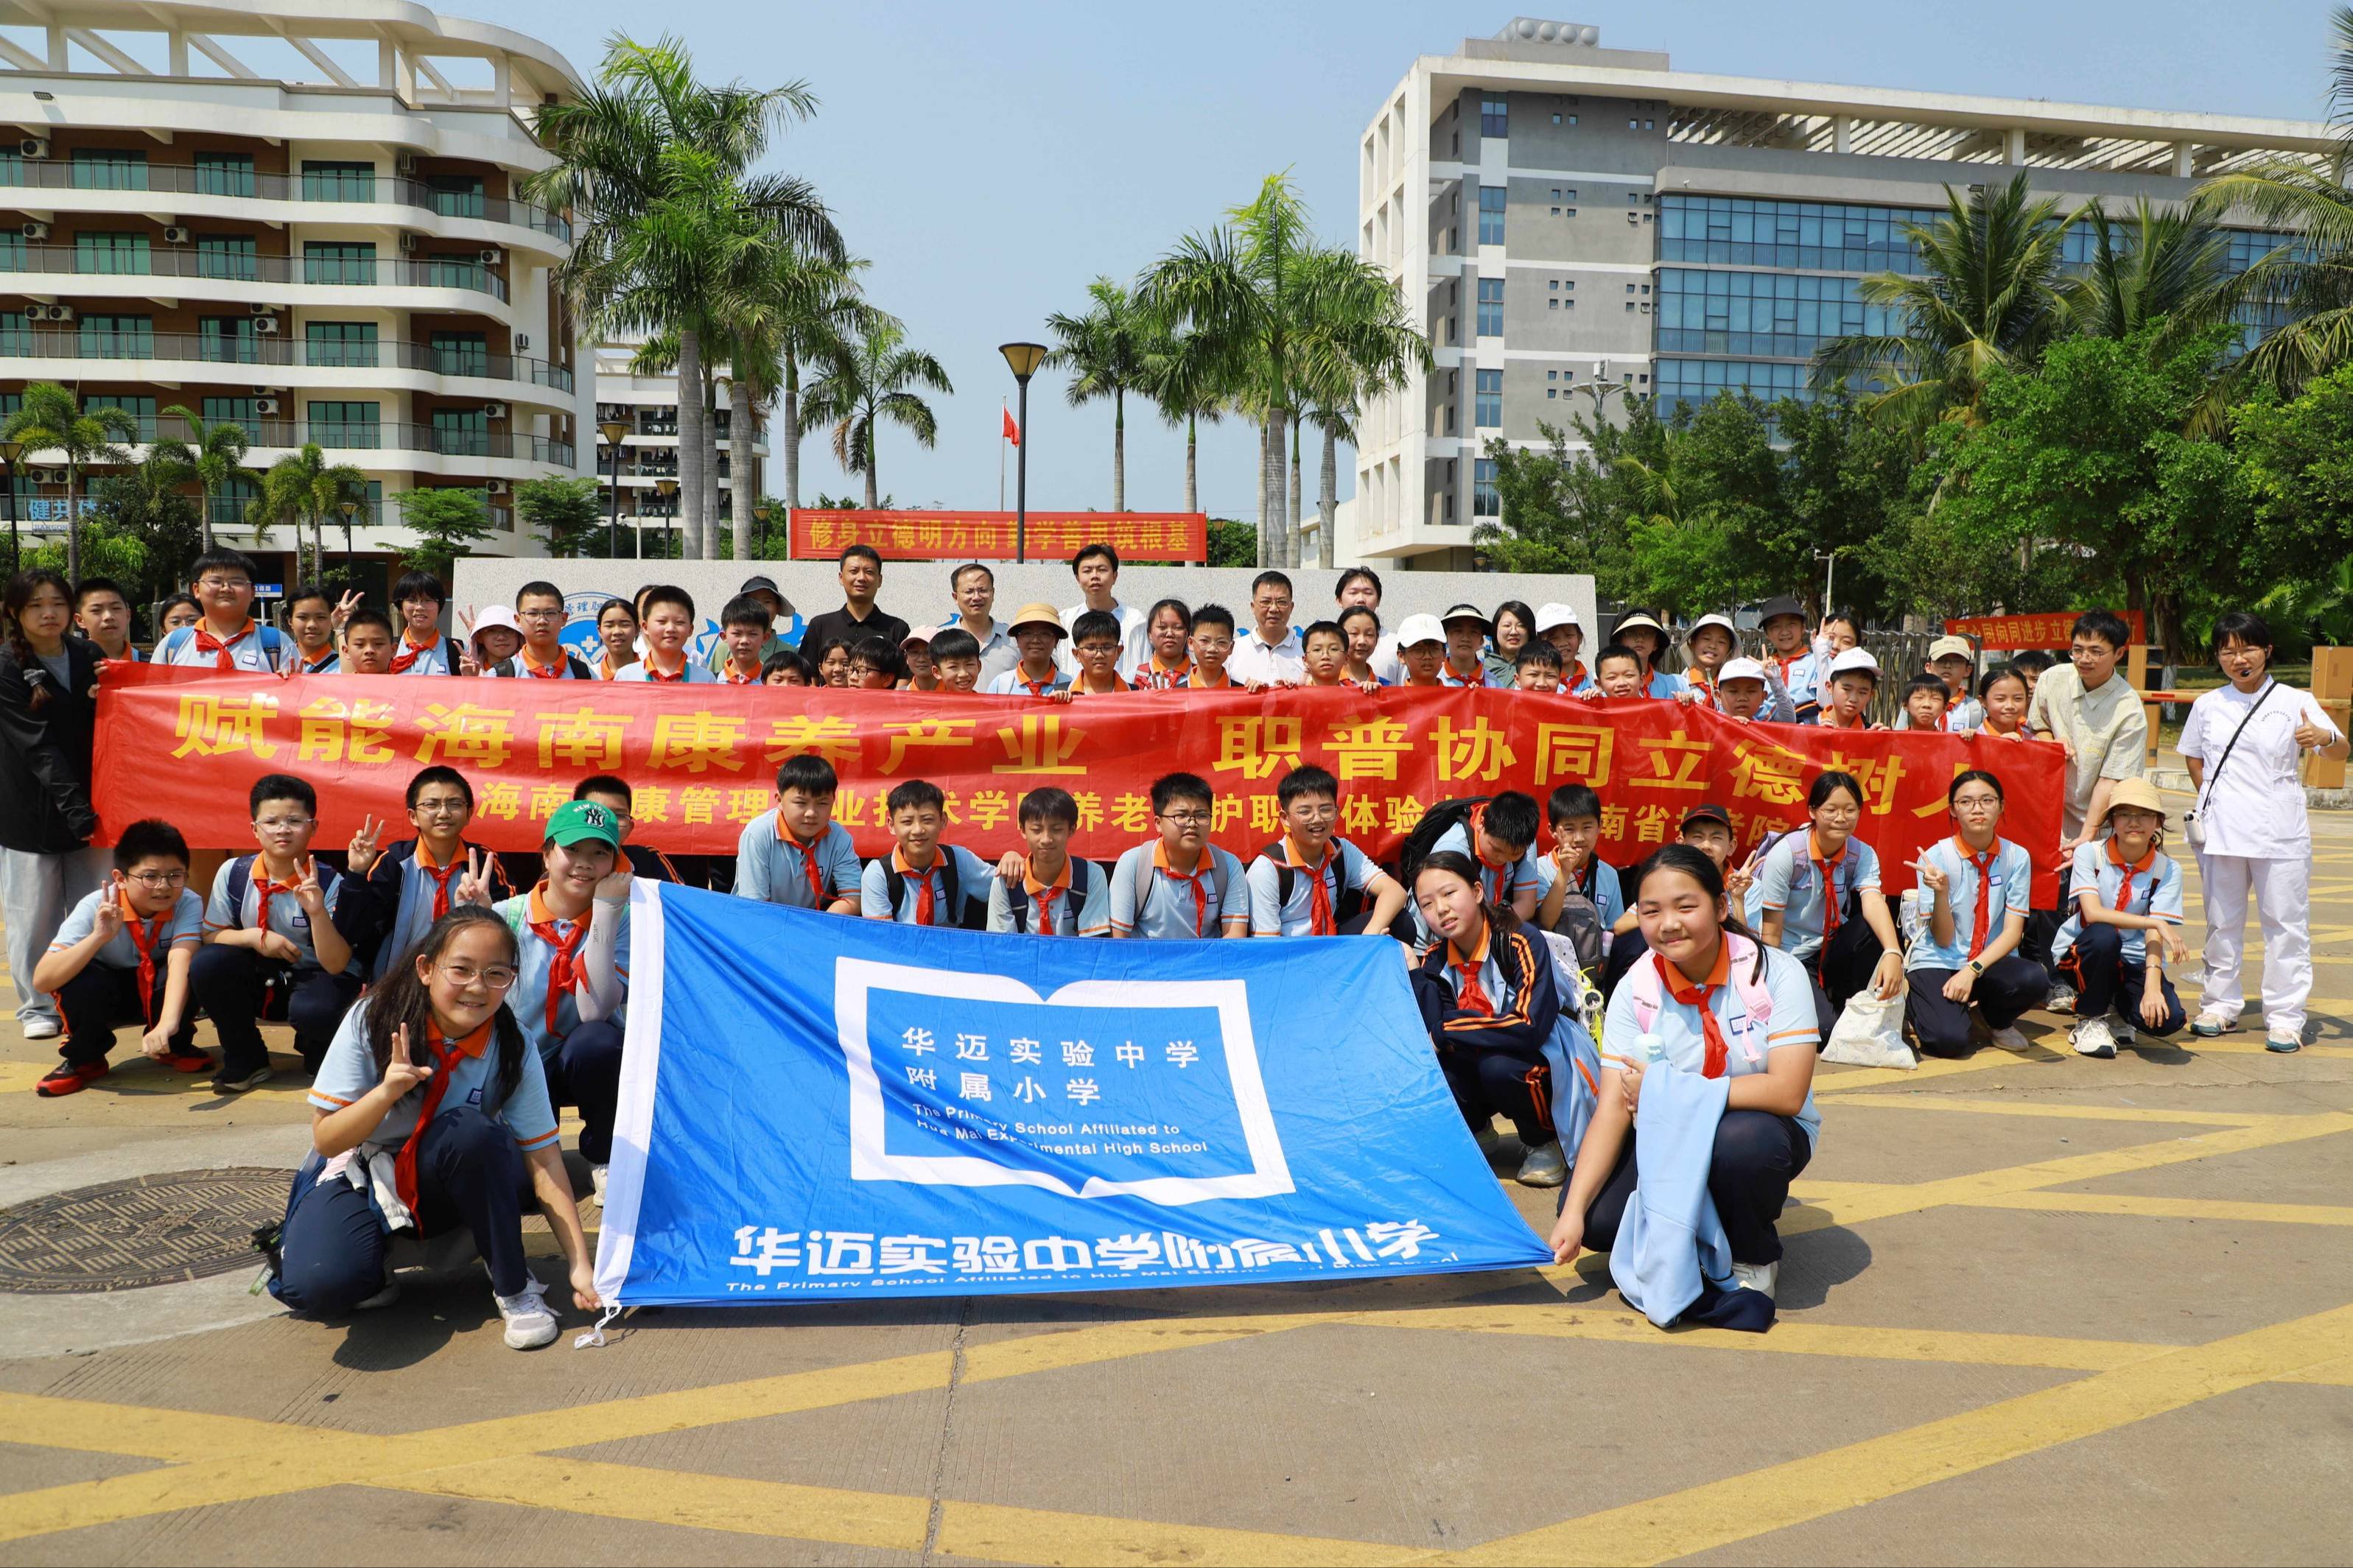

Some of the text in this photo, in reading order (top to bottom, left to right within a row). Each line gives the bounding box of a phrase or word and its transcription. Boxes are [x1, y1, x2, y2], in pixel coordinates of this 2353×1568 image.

[810, 518, 1189, 552] 修身立德明方向 勤学善思筑根基
[171, 692, 1087, 776] 赋能海南康养产业
[572, 803, 590, 812] NEW
[901, 1026, 1199, 1069] 华迈实验中学
[905, 1065, 1101, 1106] 附属小学
[912, 1103, 941, 1117] The
[1014, 1122, 1073, 1135] School
[1080, 1122, 1157, 1135] Affiliated
[1163, 1124, 1180, 1135] to
[916, 1118, 950, 1137] Hua
[954, 1126, 983, 1140] Mai
[1104, 1142, 1143, 1156] High
[1149, 1141, 1208, 1154] School
[726, 1282, 766, 1292] The
[871, 1277, 944, 1287] School
